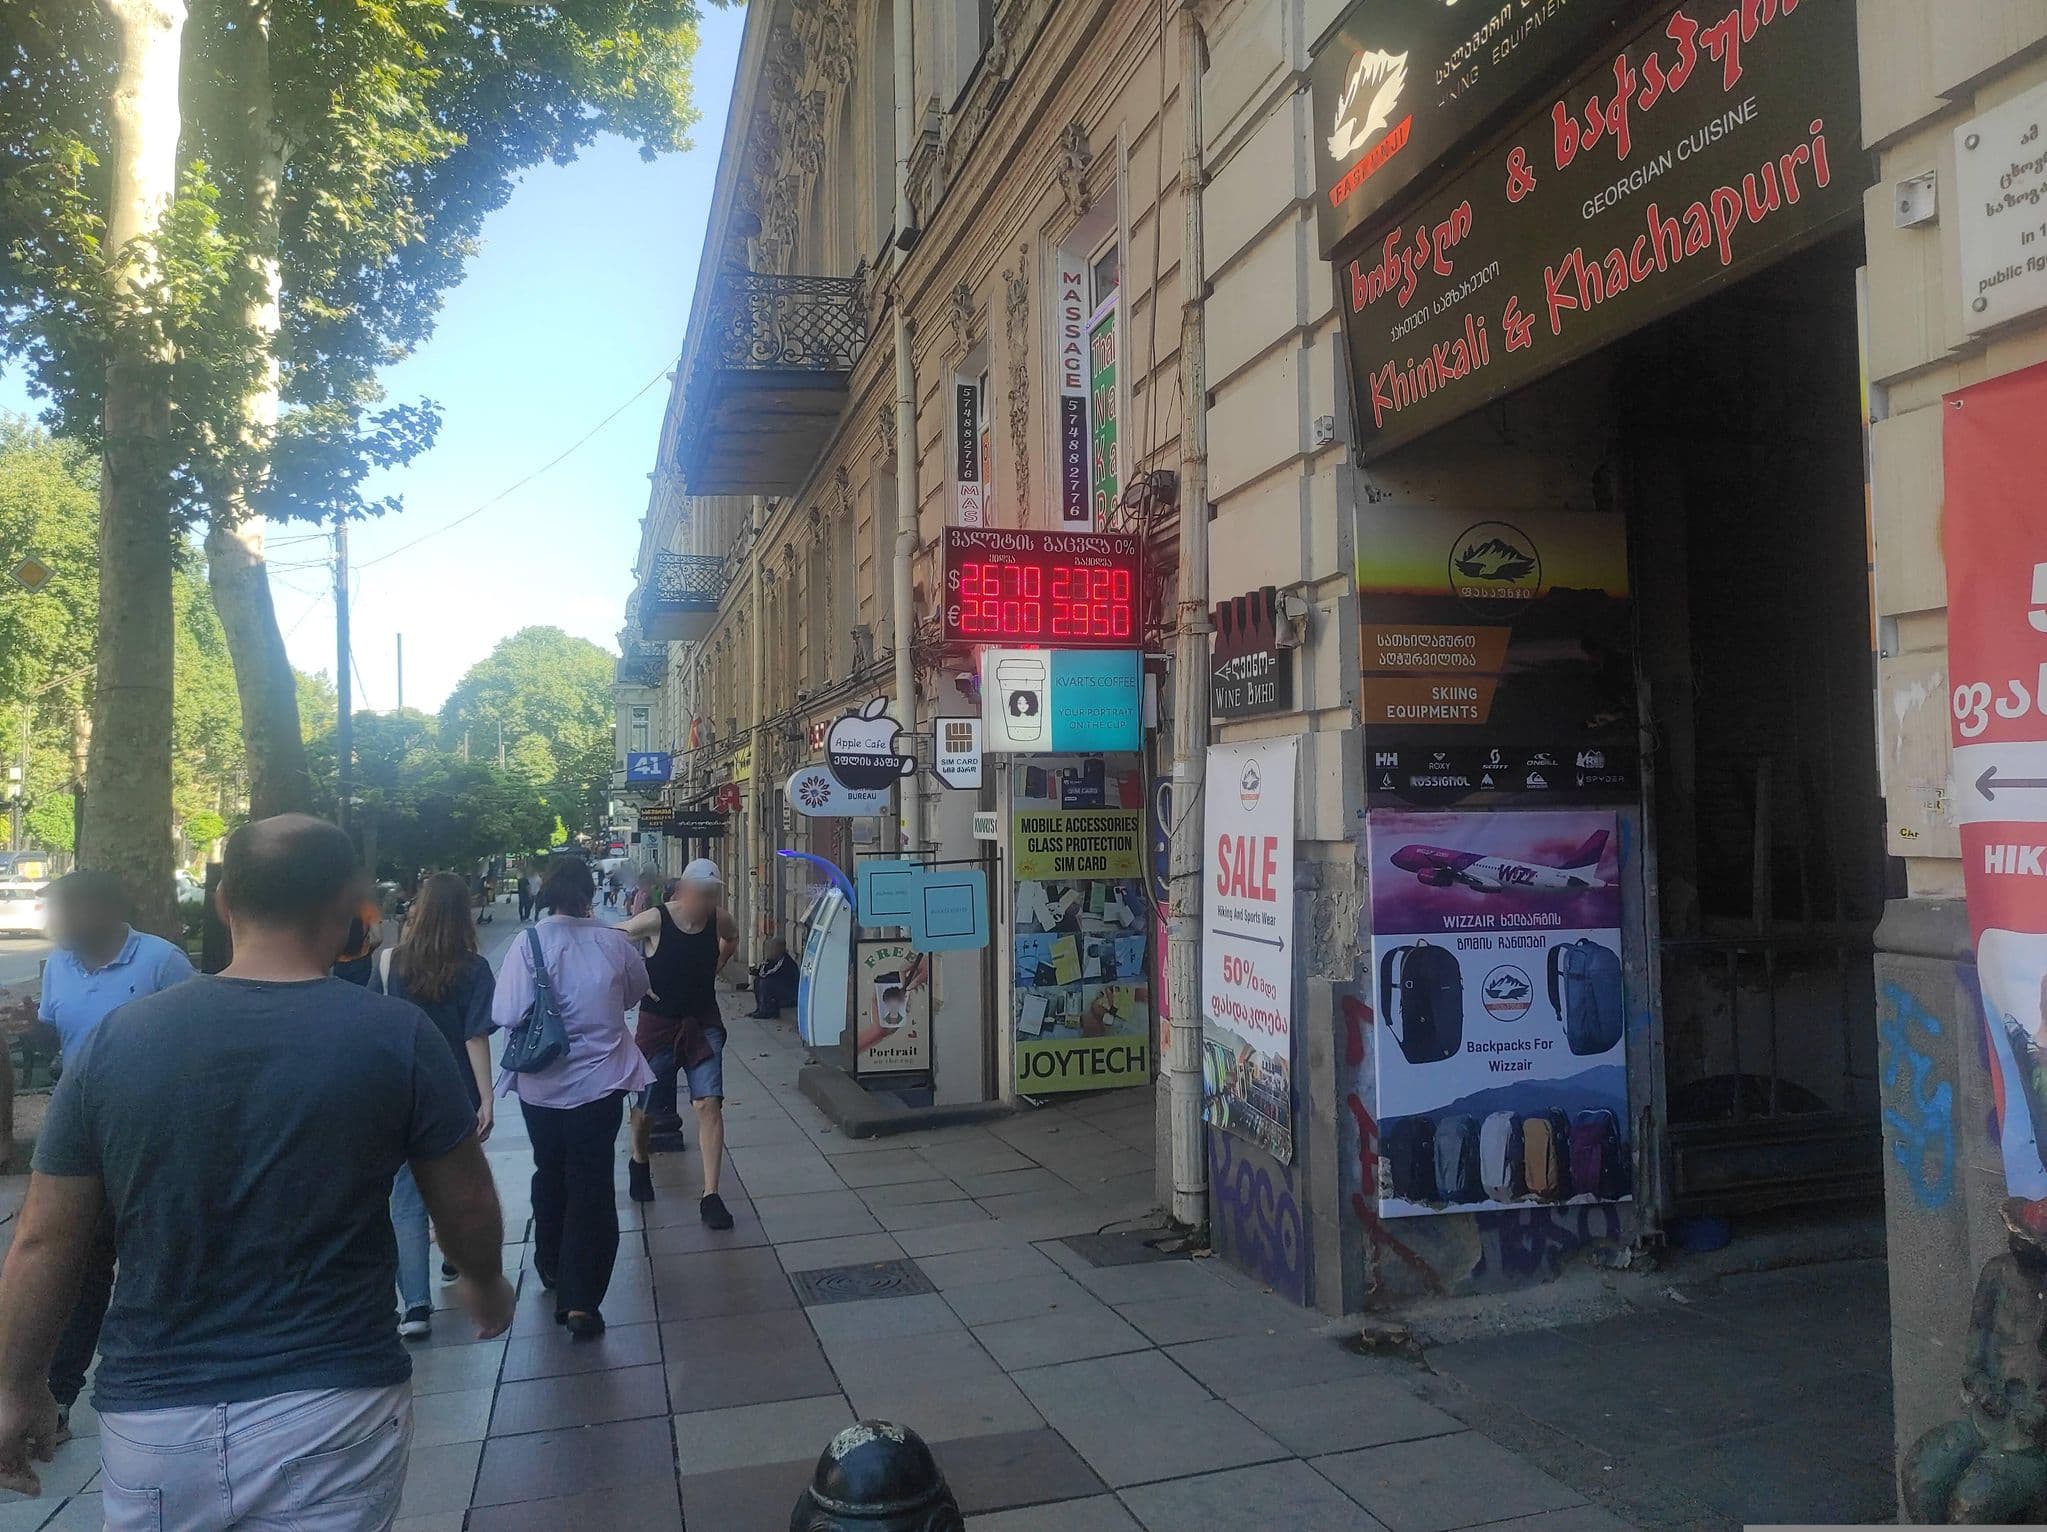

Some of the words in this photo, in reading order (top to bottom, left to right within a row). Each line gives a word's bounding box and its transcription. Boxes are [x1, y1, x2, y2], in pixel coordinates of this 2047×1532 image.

[2020, 123, 2039, 145] ამ
[1581, 150, 1673, 220] GEORGIAN
[1676, 96, 1759, 161] CUISINE
[1505, 146, 1537, 203] &
[1369, 313, 1490, 429] Khinkali
[1544, 118, 1831, 336] Khachapuri
[1979, 264, 2023, 294] public
[1432, 260, 1500, 316] სამზარეულო
[1063, 271, 1082, 389] MASSAGE
[962, 387, 973, 479] 574882776
[1066, 399, 1080, 517] 574882776
[961, 485, 980, 528] MAS
[951, 530, 1035, 551] ვალუტის
[1043, 535, 1111, 554] გაცვლა
[1114, 539, 1136, 556] 0%
[947, 567, 961, 592] $
[947, 604, 961, 628] €
[1376, 633, 1476, 648] სათხილამურო
[1056, 676, 1096, 688] KVARTS
[1097, 676, 1136, 688] COFFEE
[1431, 687, 1478, 701] SKIING
[1059, 708, 1086, 717] YOUR
[1387, 705, 1478, 719] EQUIPMENTS
[835, 737, 862, 750] Apple
[864, 738, 887, 750] Cafe
[633, 756, 662, 775] 41
[941, 758, 955, 766] SIM
[1428, 762, 1451, 770] ROXY
[848, 792, 877, 800] BUREAU
[1021, 817, 1063, 833] MOBILE
[1065, 816, 1138, 833] ACCESSORIES
[1028, 837, 1064, 853] GLASS
[1066, 836, 1132, 852] PROTECTION
[1054, 857, 1076, 872] SIM
[1077, 856, 1107, 871] CARD
[1216, 833, 1278, 903] SALE
[1217, 905, 1233, 922] Hiking
[1233, 907, 1244, 920] And
[1244, 909, 1261, 925] Sports
[1261, 911, 1277, 926] Wear
[1443, 914, 1495, 929] WIZZAIR
[1456, 937, 1493, 951] ზომის
[1223, 954, 1259, 991] 50%
[1211, 994, 1288, 1036] ფასდაკლება
[869, 1046, 918, 1058] Portrait
[1466, 1038, 1532, 1055] Backpacks
[1534, 1038, 1554, 1050] For
[1019, 1045, 1146, 1080] JOYTECH
[1488, 1058, 1533, 1073] Wizzair
